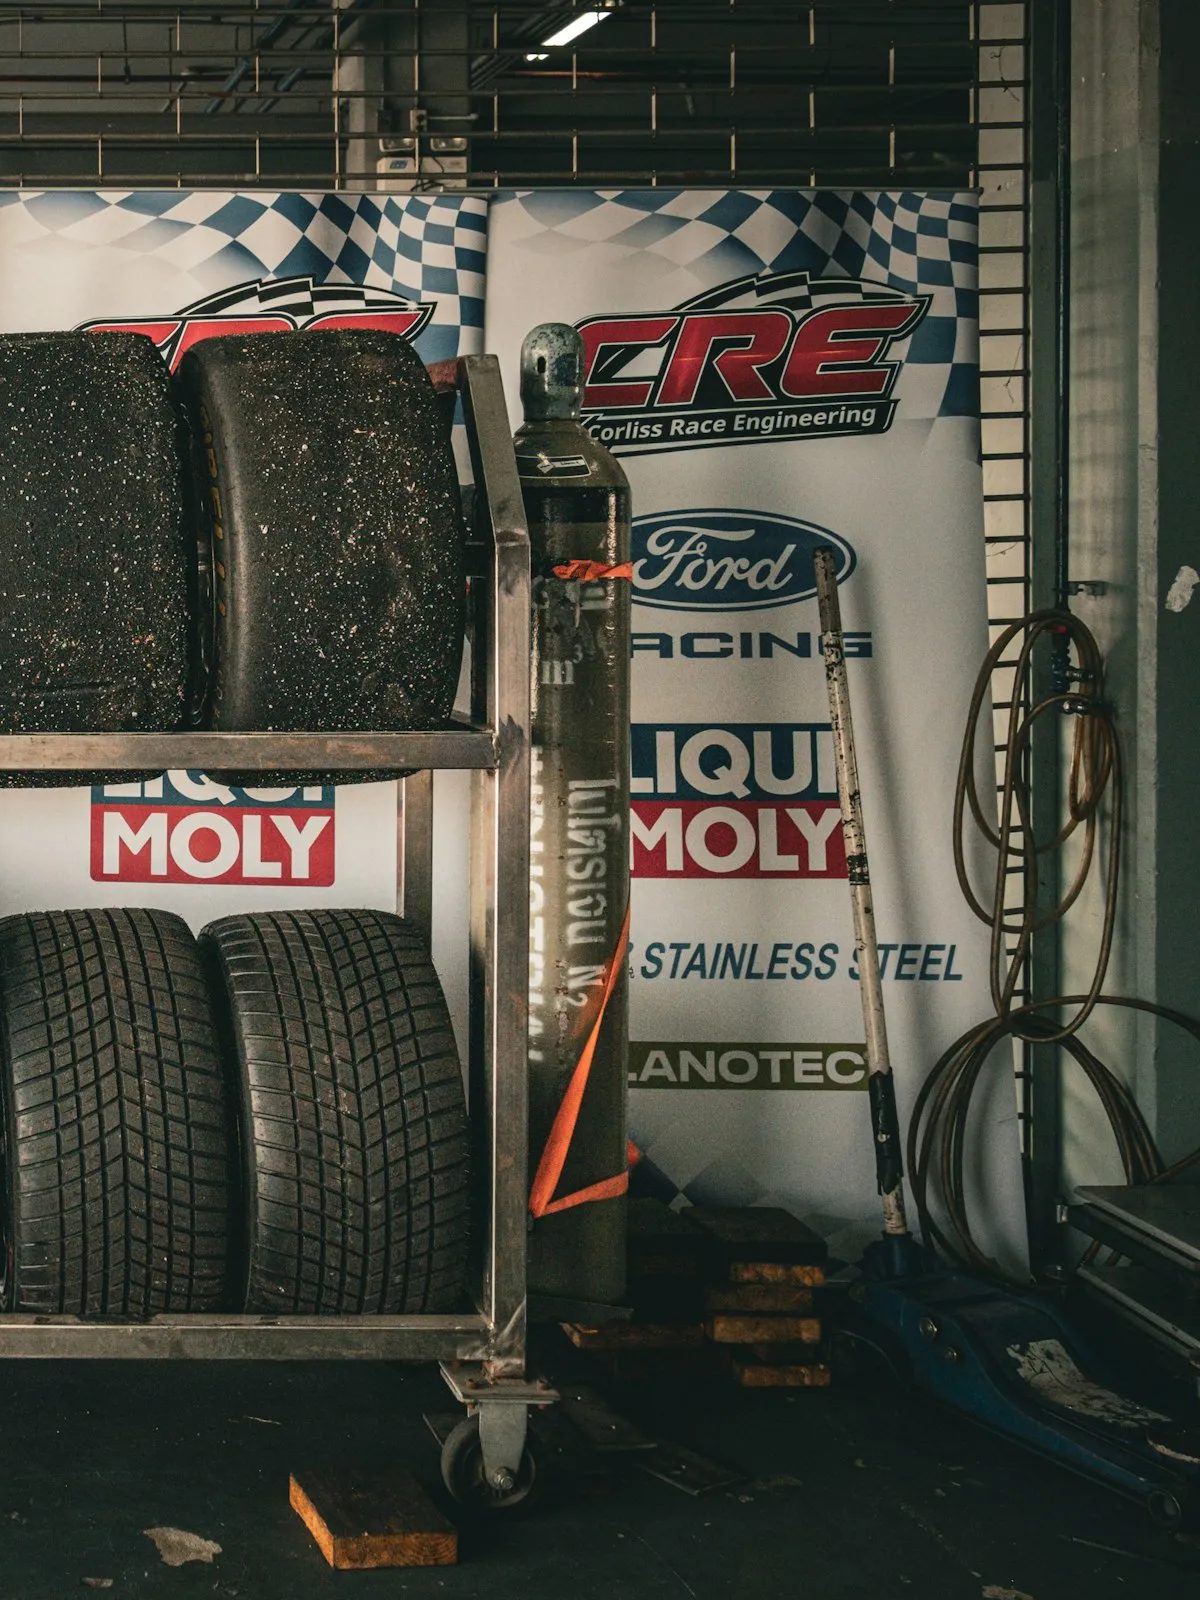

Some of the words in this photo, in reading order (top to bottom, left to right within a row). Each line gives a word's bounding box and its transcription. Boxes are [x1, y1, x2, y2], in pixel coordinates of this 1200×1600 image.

[582, 304, 921, 408] CRE
[588, 421, 663, 441] Corliss
[669, 418, 726, 436] Race
[733, 406, 877, 434] Engineering
[632, 525, 796, 592] Ford
[629, 631, 874, 659] ACING
[102, 811, 332, 879] MOLY
[629, 805, 843, 874] MOLY
[640, 941, 839, 980] STAINLESS
